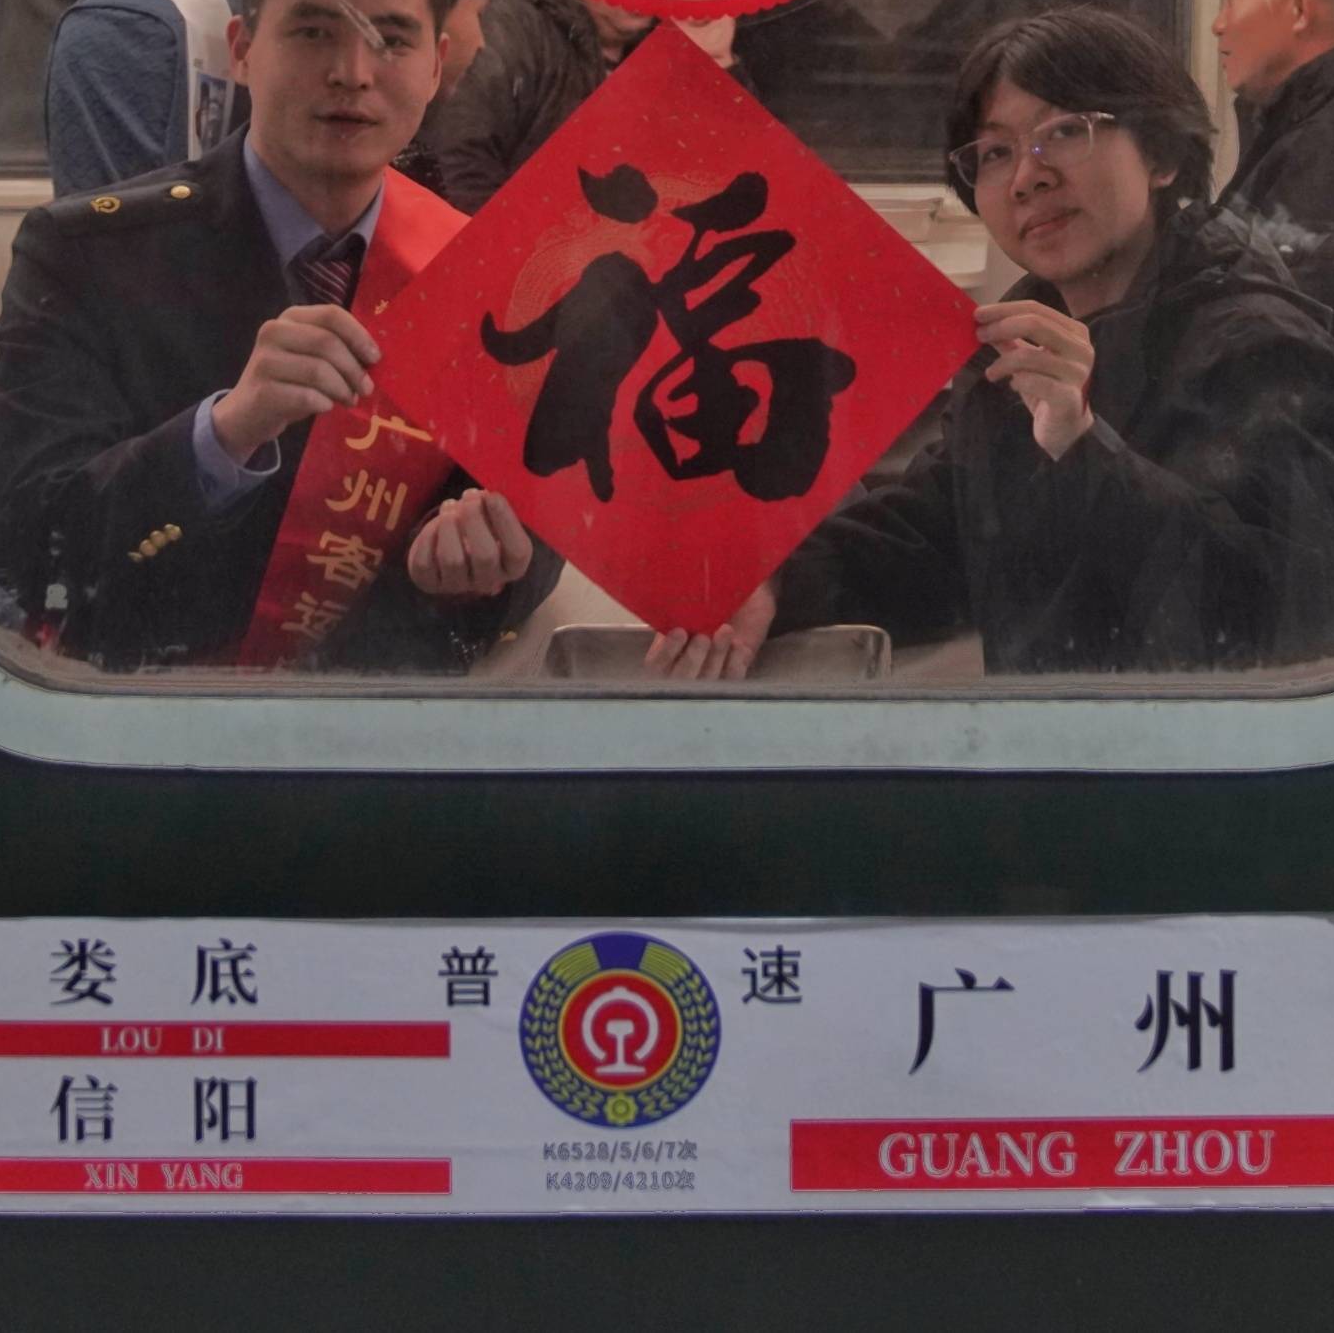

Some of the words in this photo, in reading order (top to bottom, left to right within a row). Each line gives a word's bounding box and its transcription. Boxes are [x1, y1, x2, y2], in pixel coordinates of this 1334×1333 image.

[481, 164, 856, 502] 福
[50, 938, 258, 1007] 娄底
[438, 947, 499, 1008] 普
[741, 945, 803, 1005] 速
[101, 1027, 163, 1053] LOU
[192, 1027, 226, 1053] DI
[910, 968, 1238, 1074] 广州
[51, 1075, 258, 1143] 信阳
[84, 1163, 139, 1189] XIN
[163, 1162, 244, 1189] YANG
[543, 1139, 698, 1162] K6528/5/6/7次
[878, 1132, 1077, 1178] GUANG
[1114, 1130, 1275, 1177] ZHOU
[546, 1169, 696, 1191] K4209/4210次
